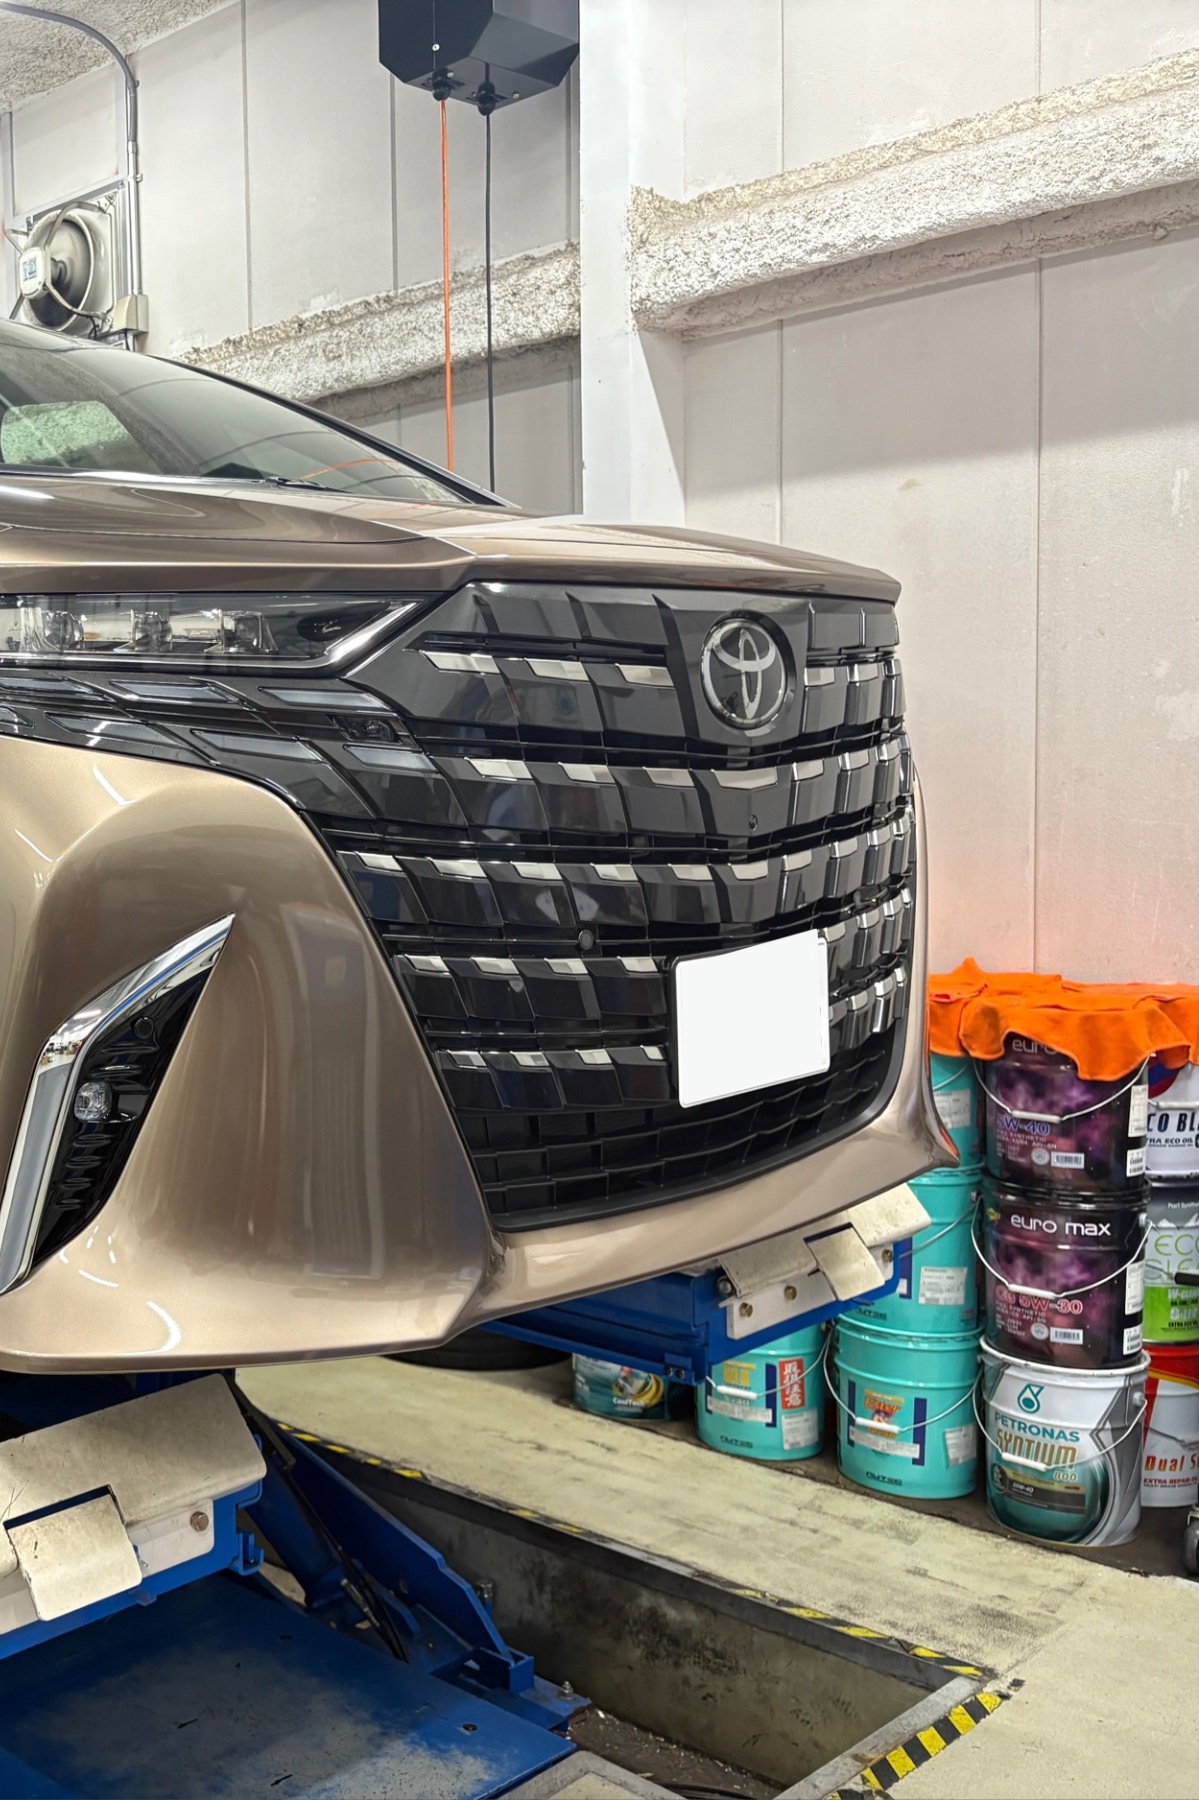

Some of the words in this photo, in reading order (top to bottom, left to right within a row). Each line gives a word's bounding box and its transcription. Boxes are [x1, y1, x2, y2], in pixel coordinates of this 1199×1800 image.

[1010, 1214, 1057, 1234] euro
[1065, 1222, 1112, 1237] max
[995, 1411, 1080, 1442] PETRONAS
[997, 1427, 1078, 1470] SYNTIUM
[1144, 1454, 1185, 1472] Dual
[1053, 1470, 1078, 1482] 800
